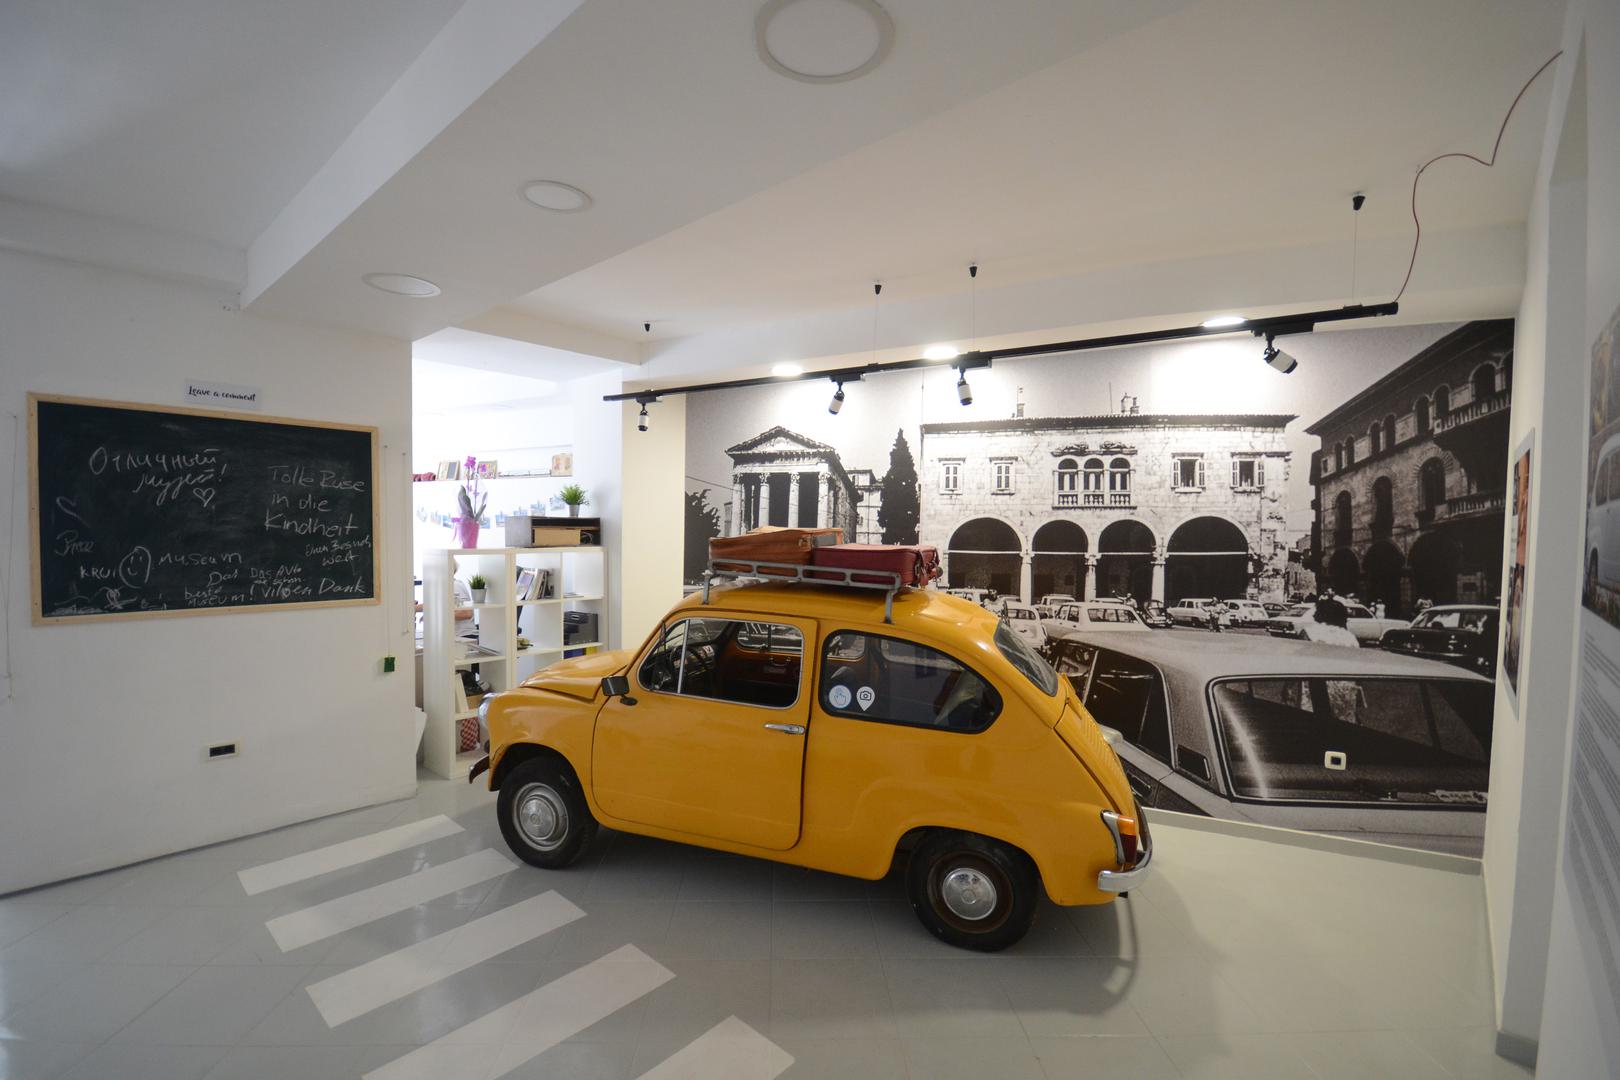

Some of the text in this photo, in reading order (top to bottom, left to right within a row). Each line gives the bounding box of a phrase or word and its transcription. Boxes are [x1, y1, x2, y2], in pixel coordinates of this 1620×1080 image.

[189, 385, 210, 397] Leave
[221, 392, 256, 402] comment
[89, 446, 219, 475] Отличный
[266, 464, 315, 488] Tolle
[271, 493, 333, 512] in die
[264, 508, 359, 538] Kindheit
[319, 576, 366, 595] Dank
